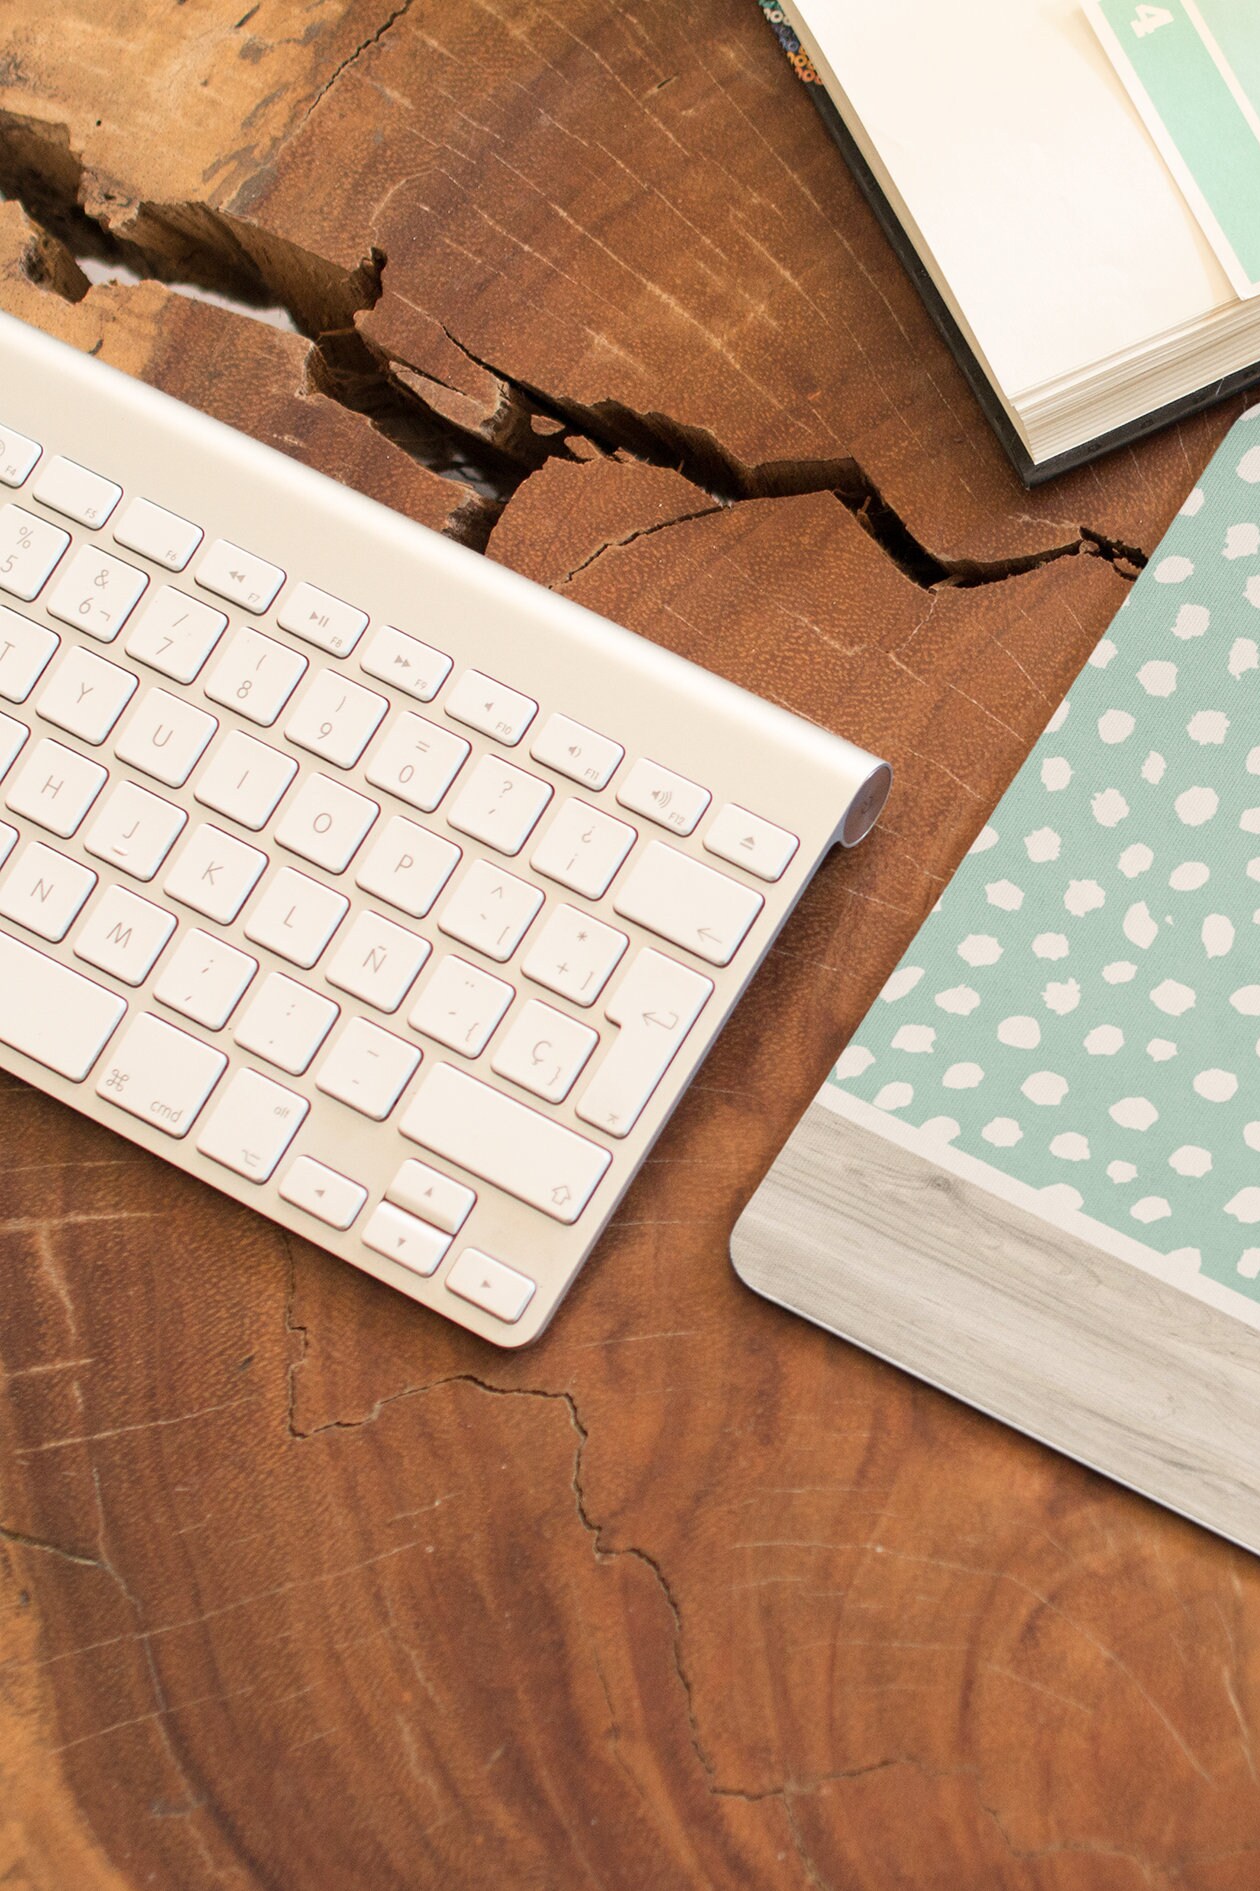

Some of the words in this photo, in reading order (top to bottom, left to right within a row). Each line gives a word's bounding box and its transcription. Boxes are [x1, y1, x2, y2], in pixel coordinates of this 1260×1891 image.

[1130, 4, 1175, 39] 4
[76, 681, 95, 704] Y
[151, 723, 174, 748] U
[40, 774, 65, 799] H
[201, 860, 224, 886] K
[393, 853, 414, 874] P
[30, 876, 55, 904] N
[106, 920, 134, 950] M
[150, 1100, 184, 1124] cmd
